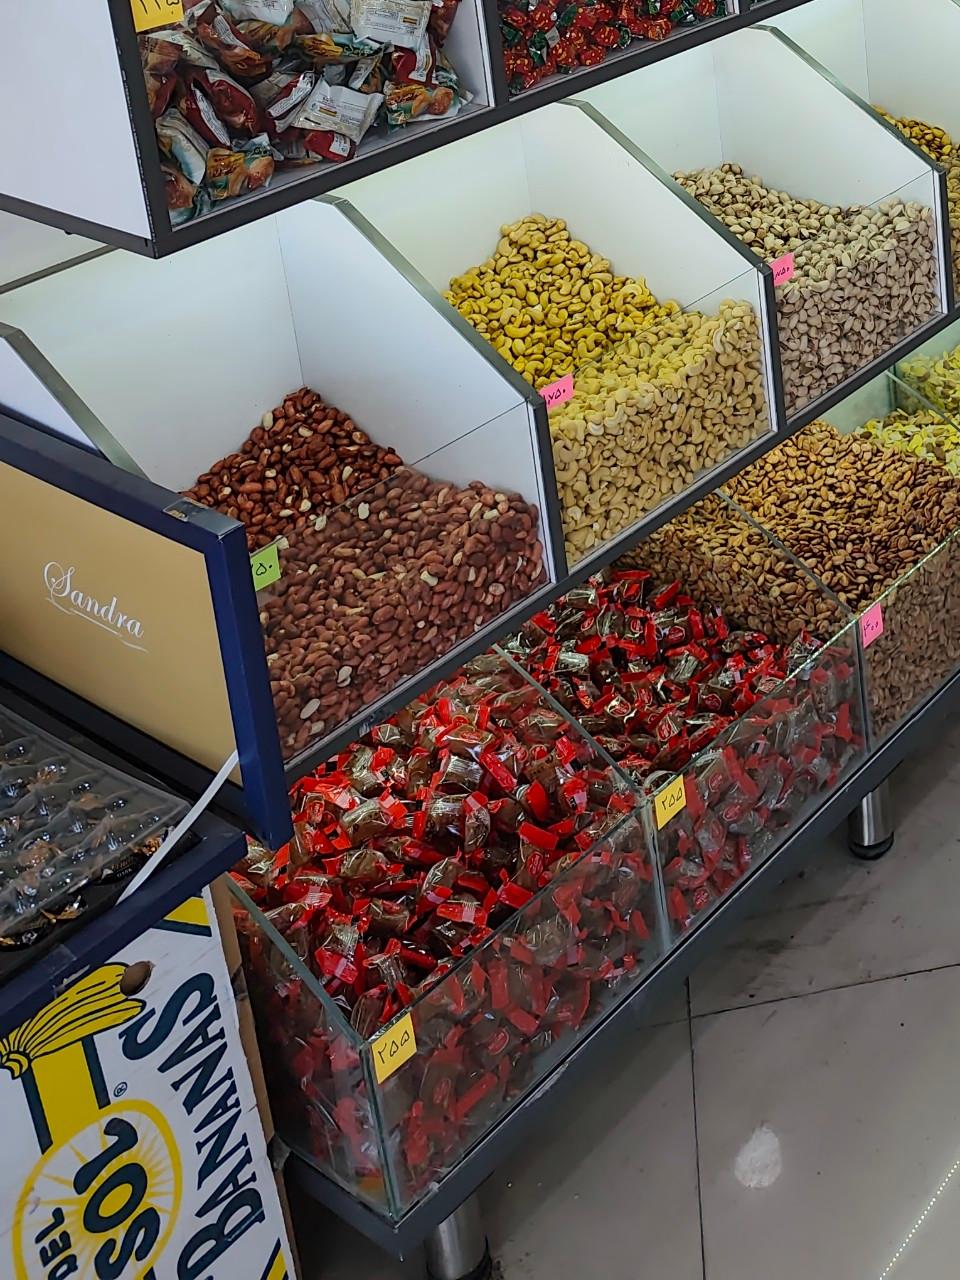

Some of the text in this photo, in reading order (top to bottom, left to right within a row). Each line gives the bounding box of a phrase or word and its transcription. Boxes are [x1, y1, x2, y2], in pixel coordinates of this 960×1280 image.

[43, 561, 145, 639] Sandra
[251, 562, 274, 577] ۵۰
[377, 1030, 410, 1065] ۲۵۵
[118, 971, 267, 1280] BANANAS
[72, 1116, 161, 1280] SOL
